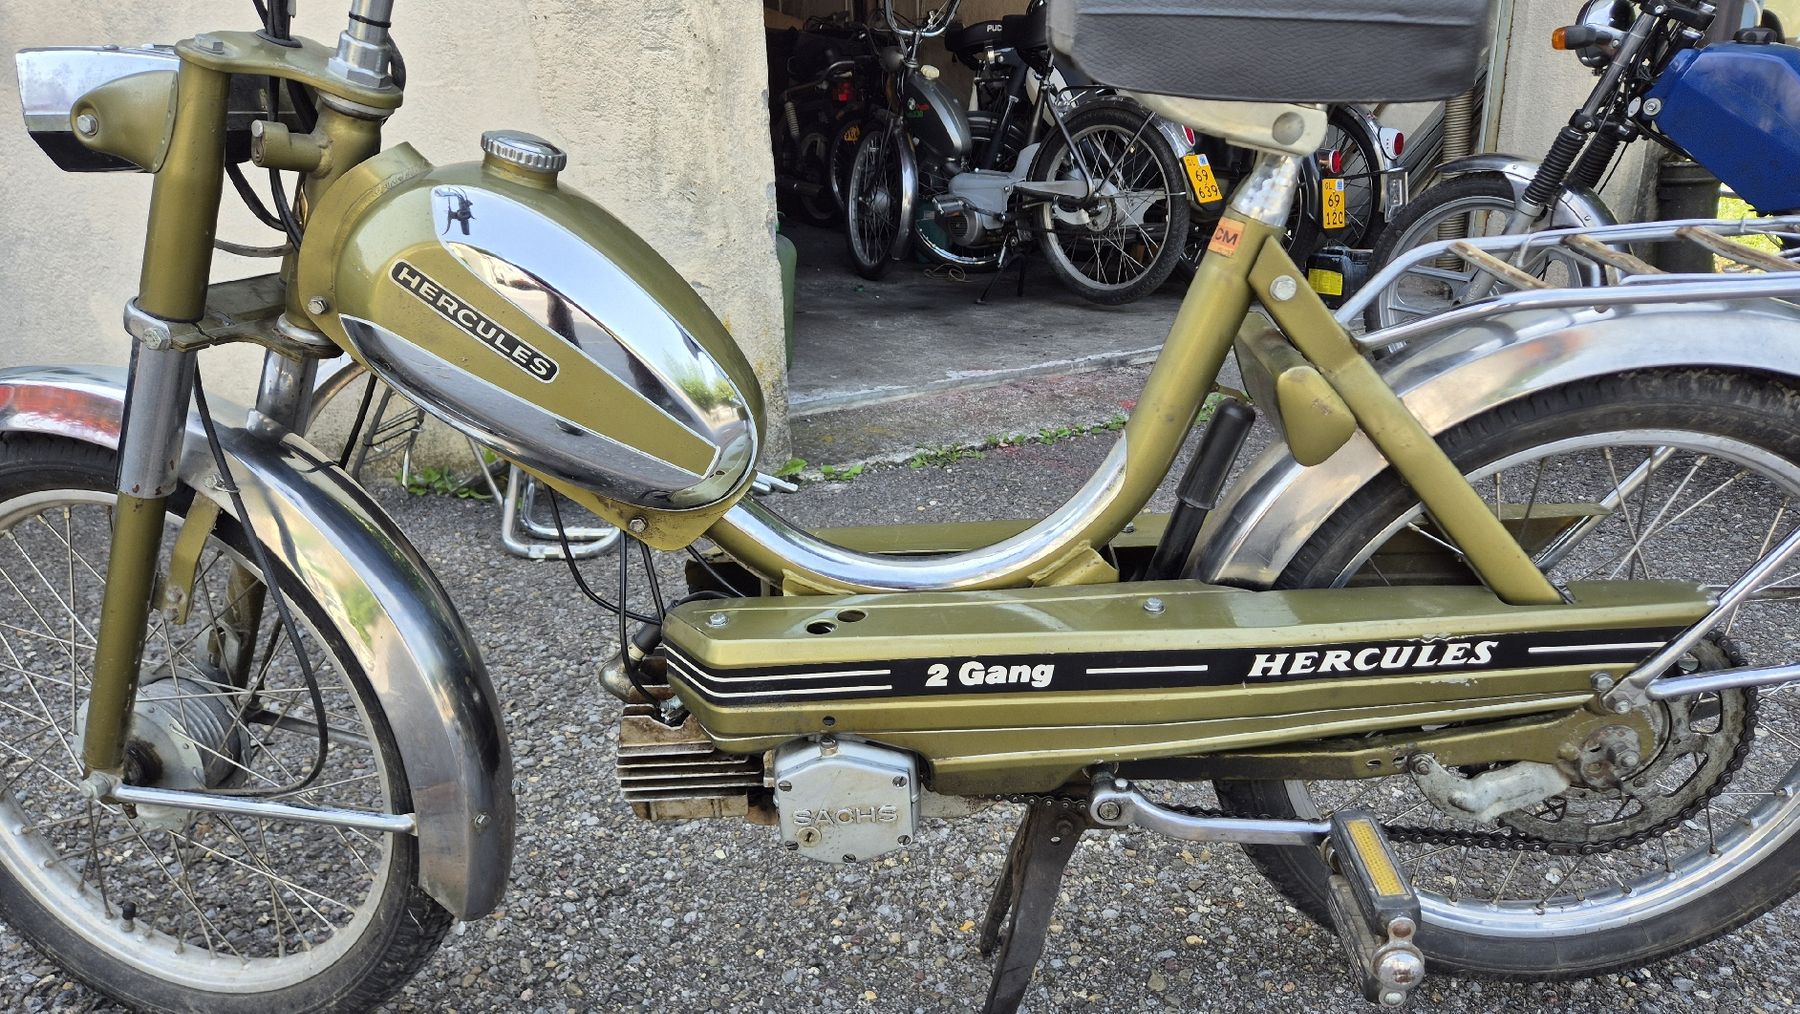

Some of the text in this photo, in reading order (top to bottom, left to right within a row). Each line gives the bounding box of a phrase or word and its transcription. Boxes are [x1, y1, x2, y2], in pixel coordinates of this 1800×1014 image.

[986, 24, 1003, 33] PUC
[1195, 169, 1208, 182] 69
[1199, 185, 1217, 199] 639
[1324, 181, 1333, 190] GL
[1328, 194, 1340, 207] 69
[1326, 211, 1343, 225] 120
[398, 267, 551, 376] HERCULES
[1247, 641, 1500, 677] HERCULES
[925, 660, 1055, 688] 2 Gang
[793, 804, 897, 827] SACHS
